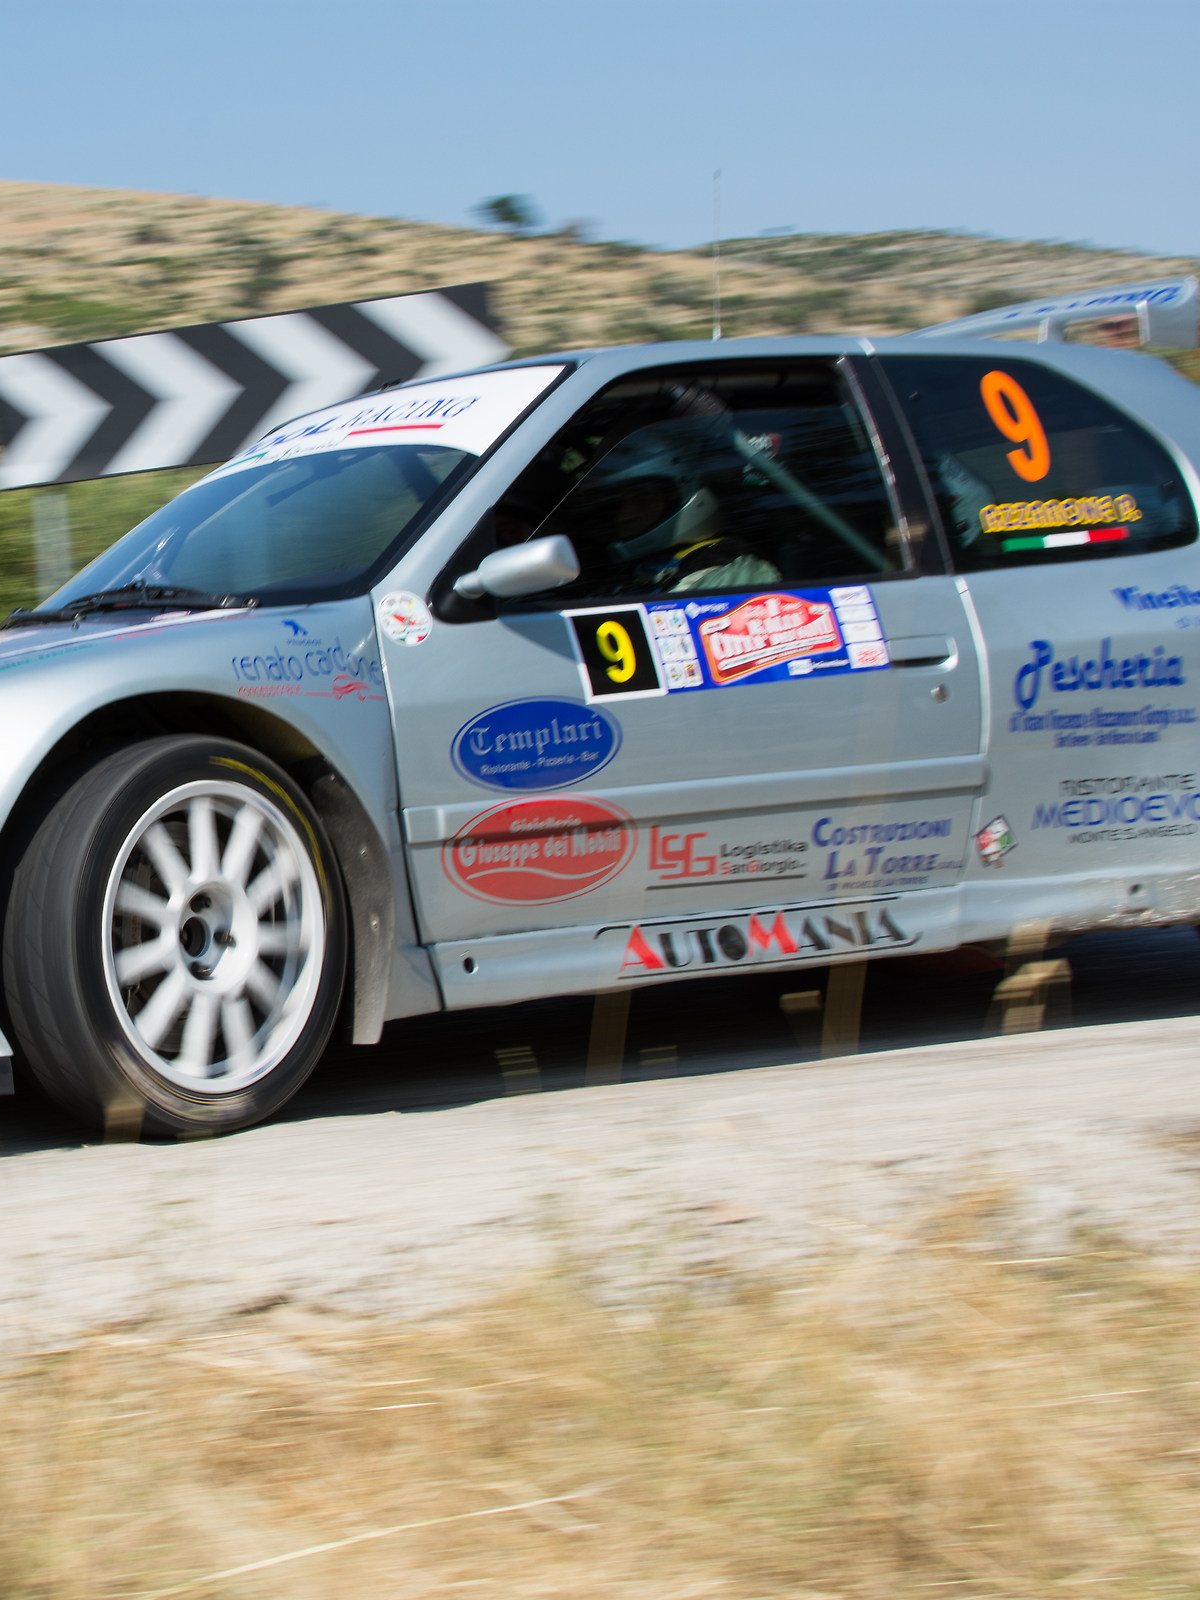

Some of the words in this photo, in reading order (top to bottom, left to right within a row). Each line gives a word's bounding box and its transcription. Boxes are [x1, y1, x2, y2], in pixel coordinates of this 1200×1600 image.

[980, 370, 1050, 482] 9
[232, 646, 303, 682] renato
[304, 636, 383, 686] cardone
[596, 620, 637, 684] 9
[1014, 636, 1187, 710] Pescheria
[469, 713, 603, 756] Templari
[1058, 773, 1196, 797] RISTORANTE
[458, 838, 540, 868] Giuseppe
[543, 833, 568, 858] dei
[719, 840, 809, 859] Logistika
[811, 817, 953, 847] COSTRUZIONI
[863, 846, 941, 876] TORRE
